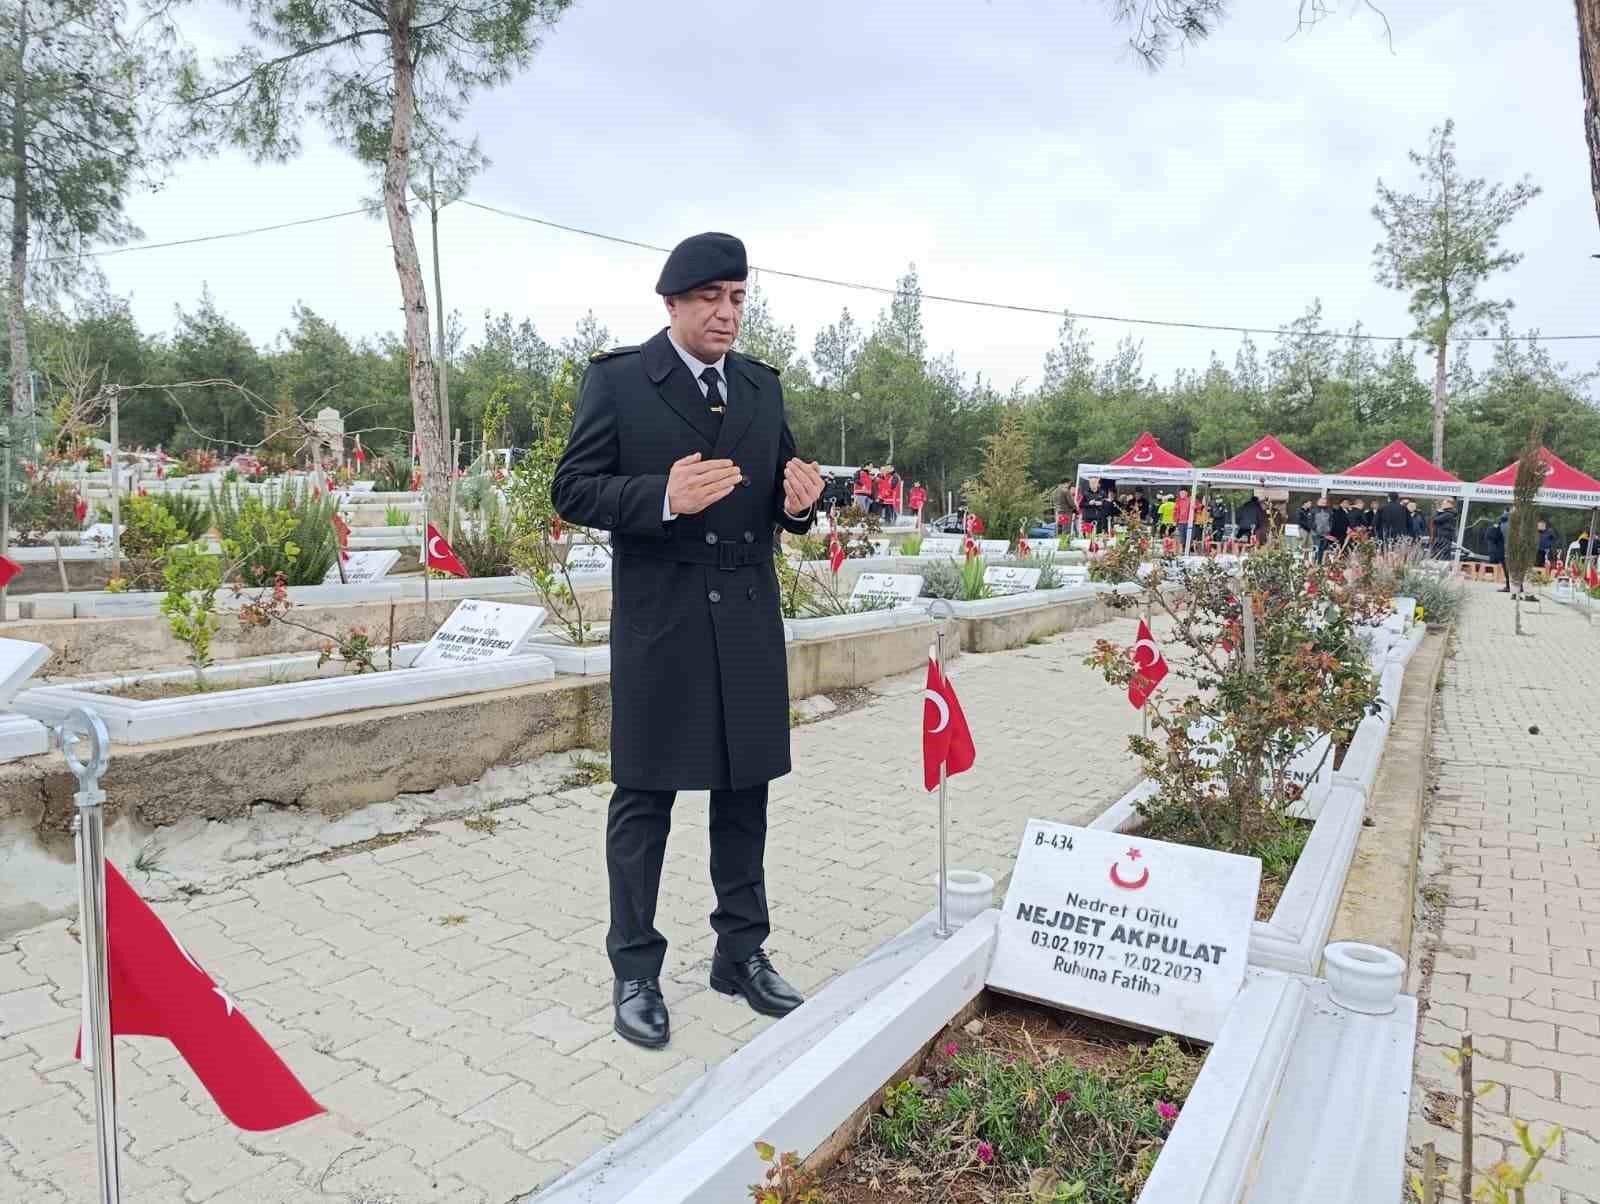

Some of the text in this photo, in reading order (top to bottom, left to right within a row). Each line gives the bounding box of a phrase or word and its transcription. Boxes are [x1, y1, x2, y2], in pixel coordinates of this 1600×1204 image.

[1034, 831, 1074, 851] B-434
[1066, 892, 1178, 929] Nedret Oğlu
[1016, 902, 1227, 965] NEJDET AKPULAT
[1031, 930, 1104, 960] 03.02.1977
[1124, 951, 1202, 984] 12.02.2023
[1053, 956, 1161, 996] Ruhuna Fatiha
